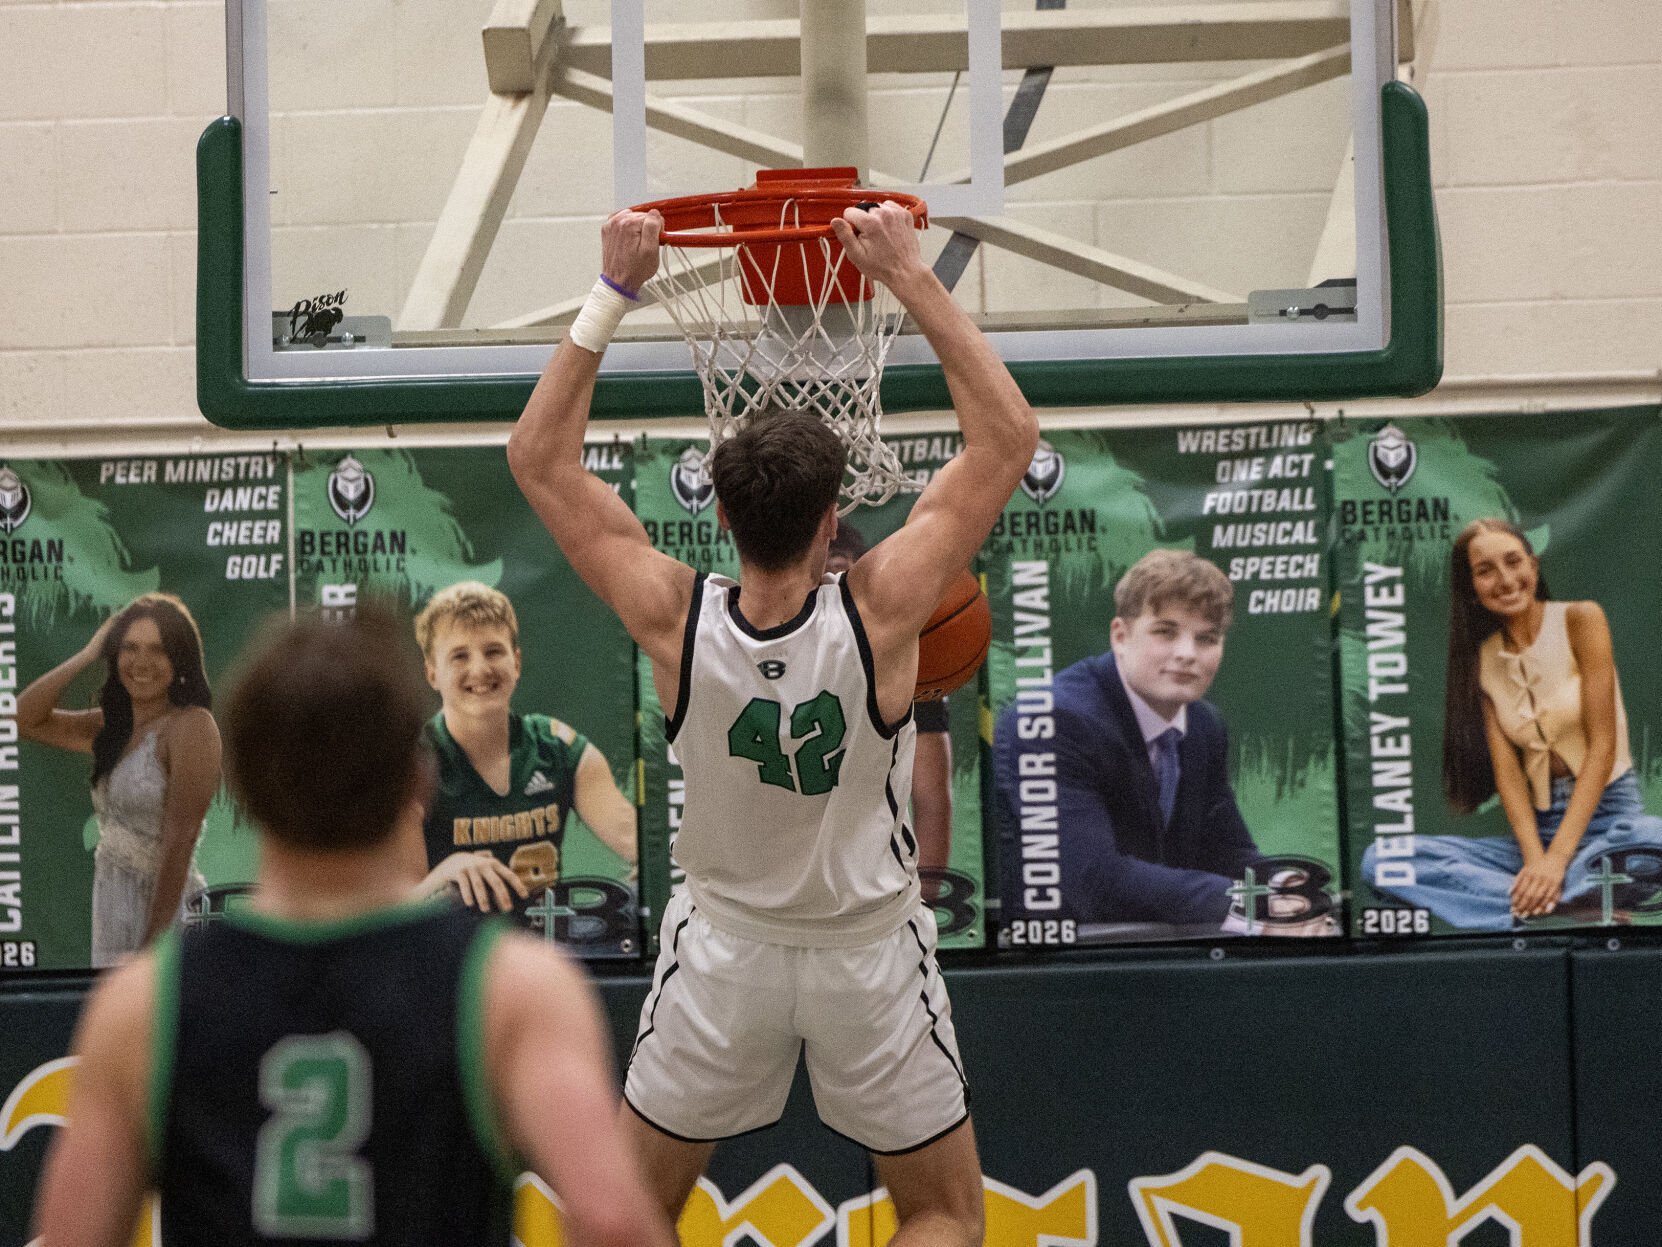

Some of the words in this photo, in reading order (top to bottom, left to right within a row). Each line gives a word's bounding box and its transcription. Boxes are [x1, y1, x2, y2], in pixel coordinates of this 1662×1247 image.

[1177, 423, 1315, 454] WRESTLING
[100, 460, 158, 485] PEER
[164, 455, 276, 483] MINISTRY
[1216, 458, 1264, 483] ONE
[1267, 454, 1314, 480] ACT
[204, 485, 282, 513] DANCE
[1202, 487, 1316, 516] FOOTBALL
[1341, 498, 1450, 525] BERGAN
[206, 519, 282, 546] CHEER
[299, 530, 407, 556] BERGAN
[1212, 520, 1318, 549] MUSICAL
[225, 553, 284, 580] GOLF
[299, 555, 407, 575] CATHOLIC
[1229, 554, 1321, 582] SPEECH
[1249, 588, 1322, 614] CHOIR
[1363, 561, 1409, 702] TOWEY
[1012, 560, 1056, 739] SULLIVAN
[728, 689, 847, 796] 42
[1370, 711, 1417, 887] DELANEY
[453, 803, 560, 846] KNIGHTS
[1018, 752, 1062, 911] CONNOR
[1012, 919, 1076, 944] 2026
[1363, 909, 1430, 935] 2026
[252, 1029, 375, 1240] 2
